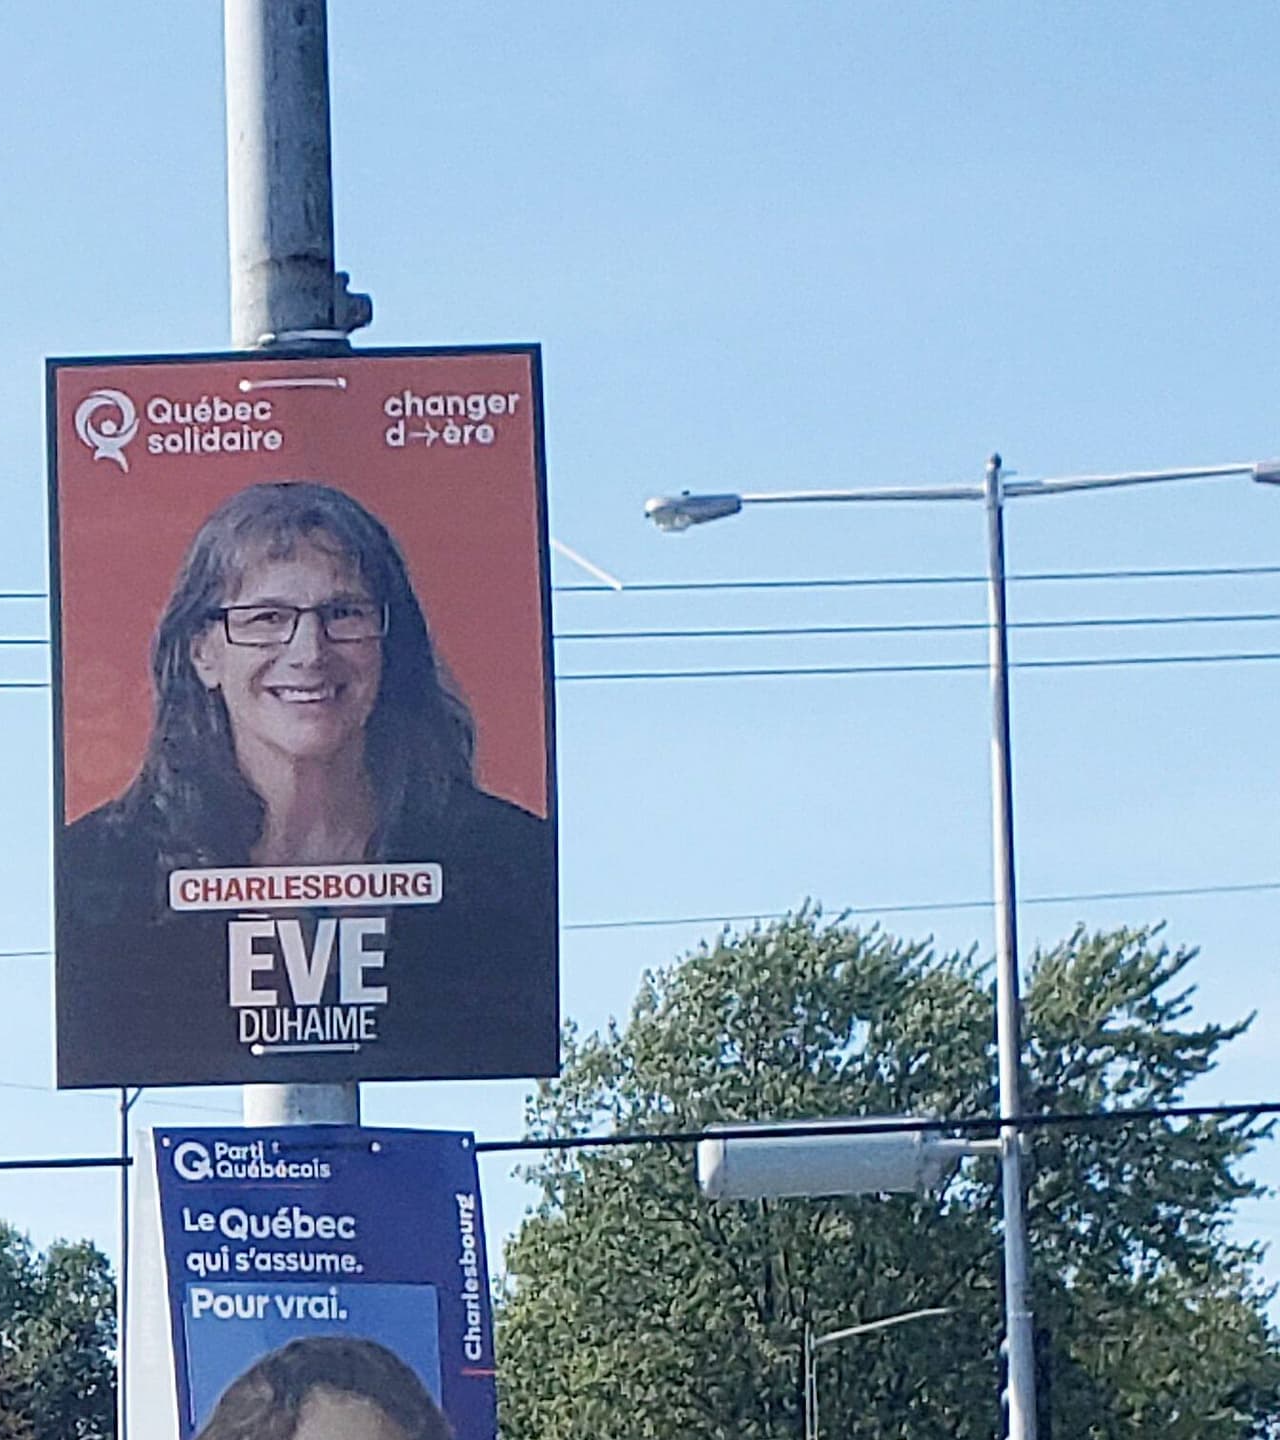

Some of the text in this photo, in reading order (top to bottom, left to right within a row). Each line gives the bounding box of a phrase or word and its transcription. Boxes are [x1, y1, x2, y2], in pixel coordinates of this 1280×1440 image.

[146, 396, 272, 424] Québec
[384, 389, 520, 420] changer
[147, 425, 283, 454] solidaire
[180, 873, 433, 902] CHARLESBOURG
[240, 1006, 378, 1043] DUHAIME
[215, 1140, 264, 1160] Parti
[216, 1158, 332, 1179] Québécois
[183, 1207, 356, 1241] Le Québec
[186, 1245, 364, 1277] qui s'assume.
[456, 1193, 482, 1361] Charlesbourg
[190, 1286, 348, 1319] Pour vrai.
